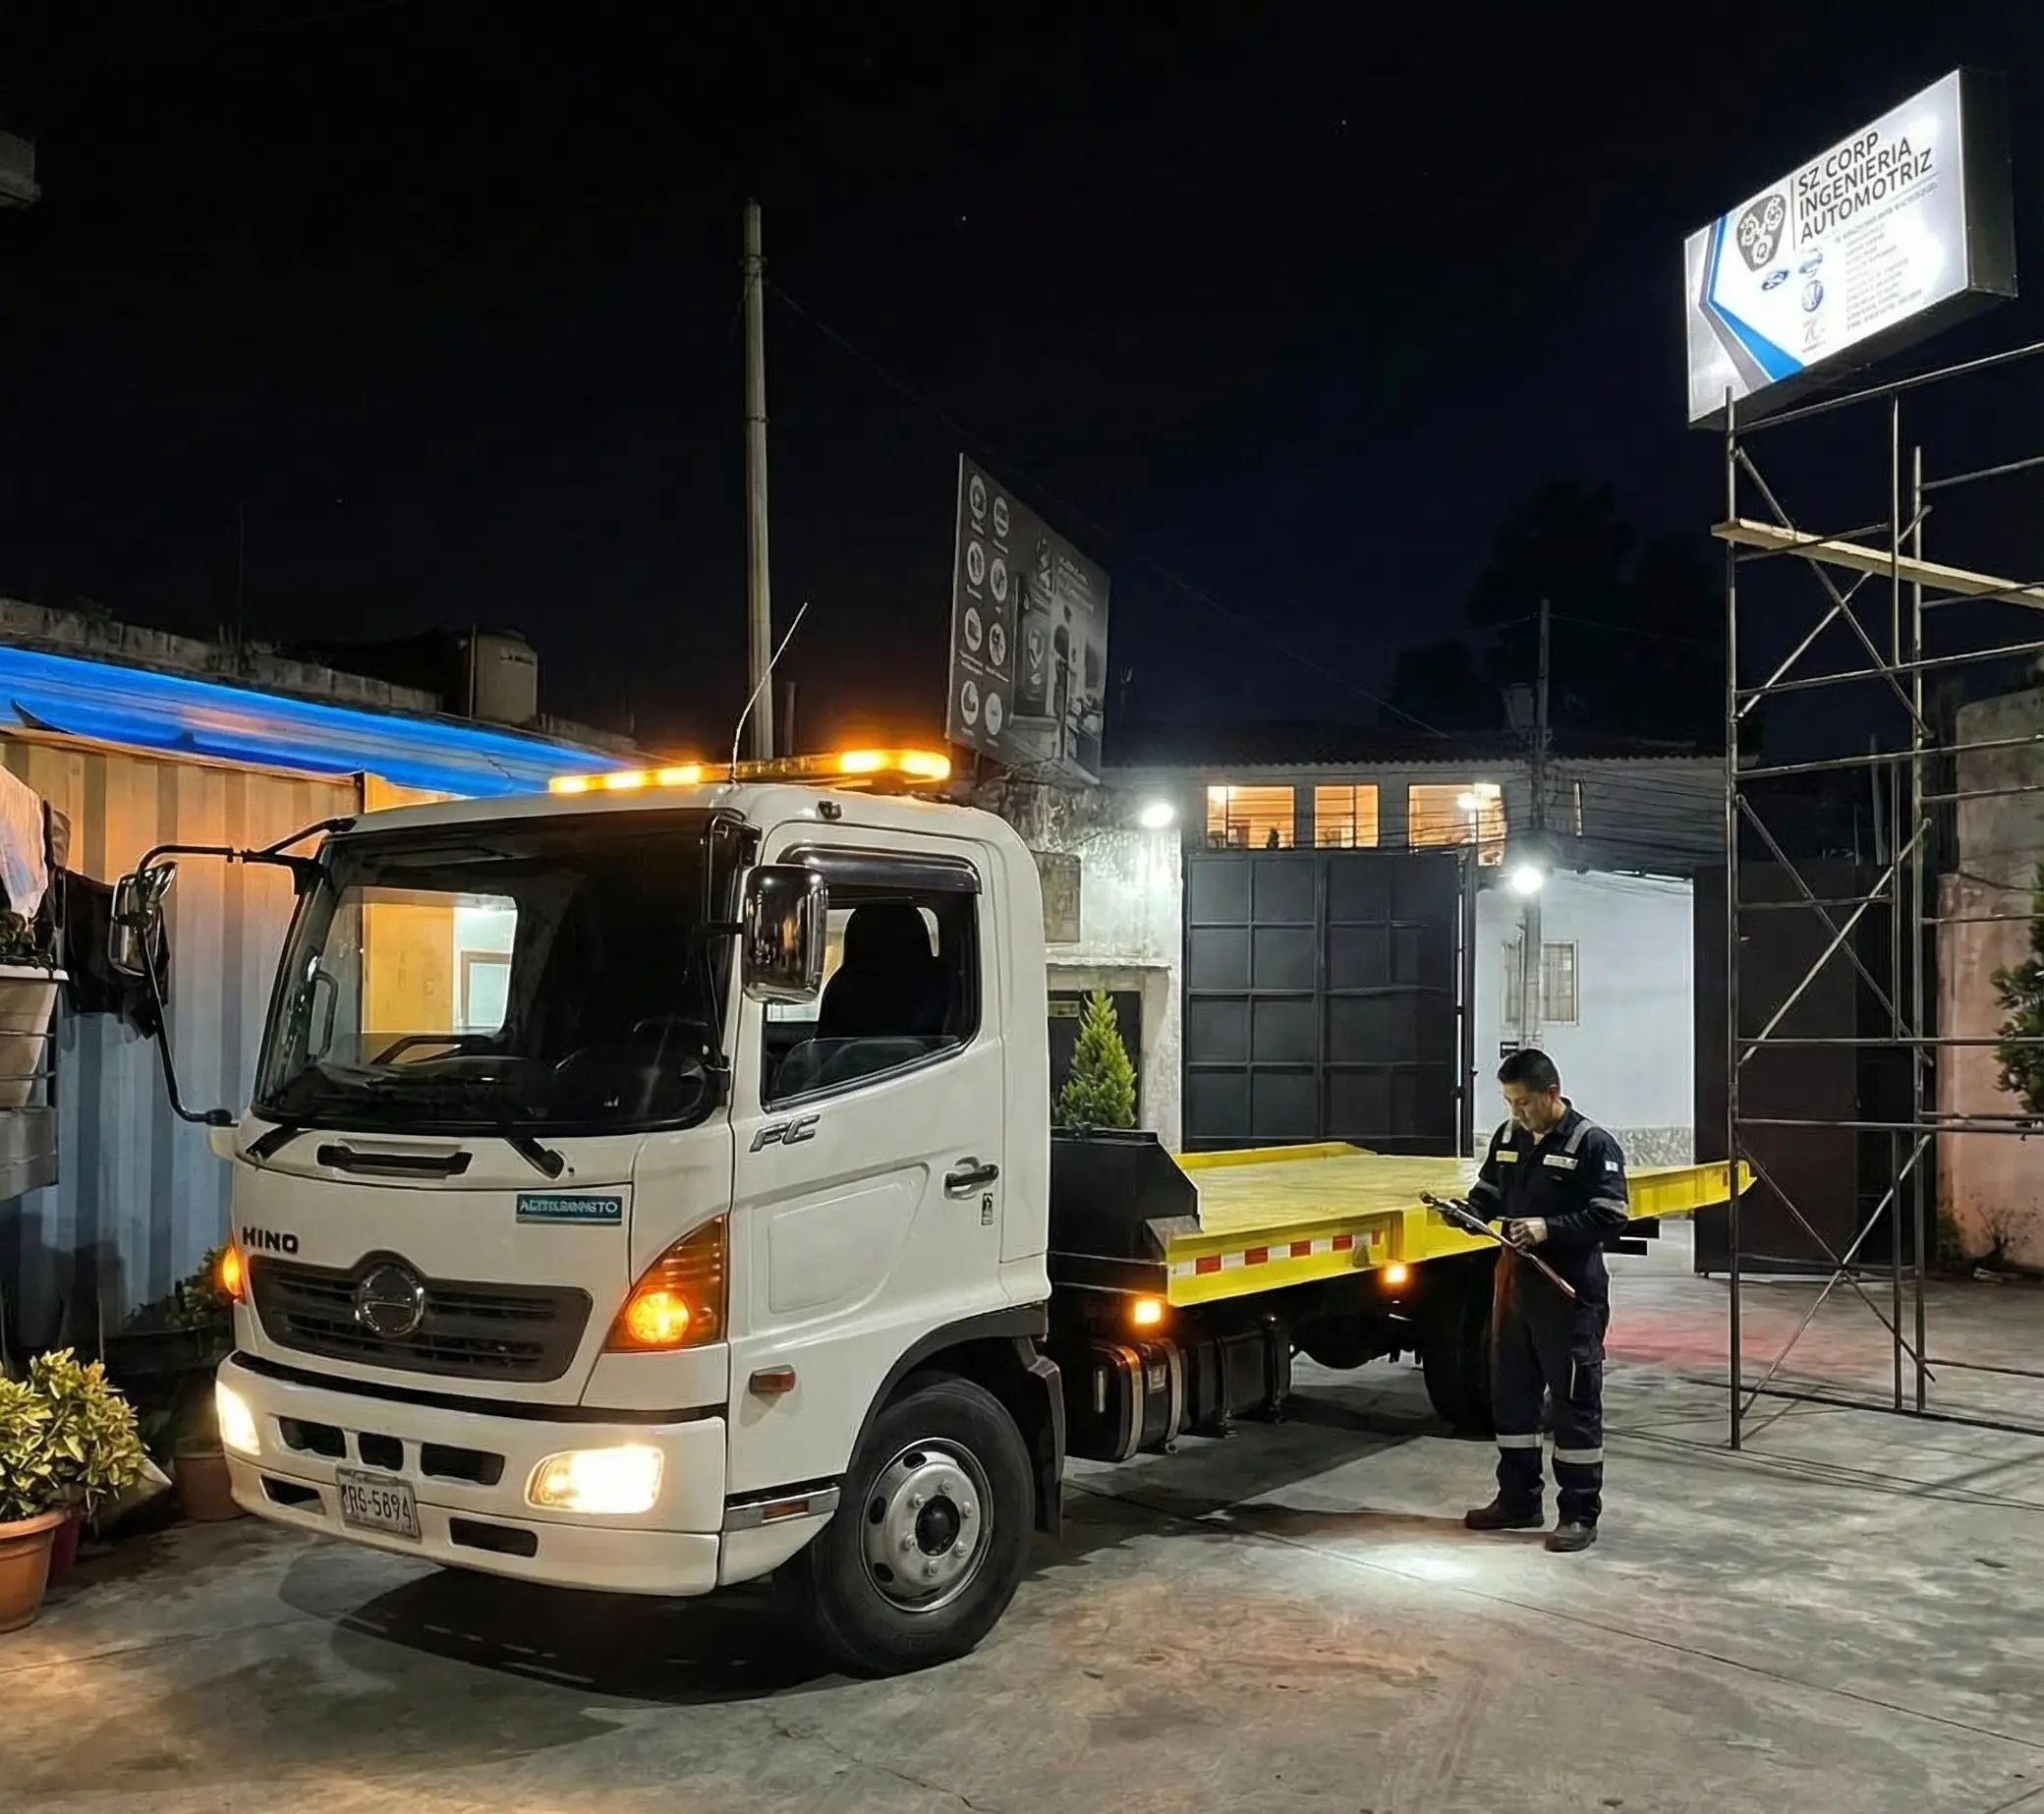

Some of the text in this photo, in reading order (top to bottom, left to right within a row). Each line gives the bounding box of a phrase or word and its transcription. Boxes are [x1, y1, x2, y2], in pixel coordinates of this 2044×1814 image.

[1798, 131, 1879, 197] SZ CORP
[1799, 137, 1912, 220] INGENIERIA
[1800, 147, 1933, 245] AUTOMOTRIZ
[749, 1113, 821, 1154] FC
[243, 1226, 299, 1255] HINO
